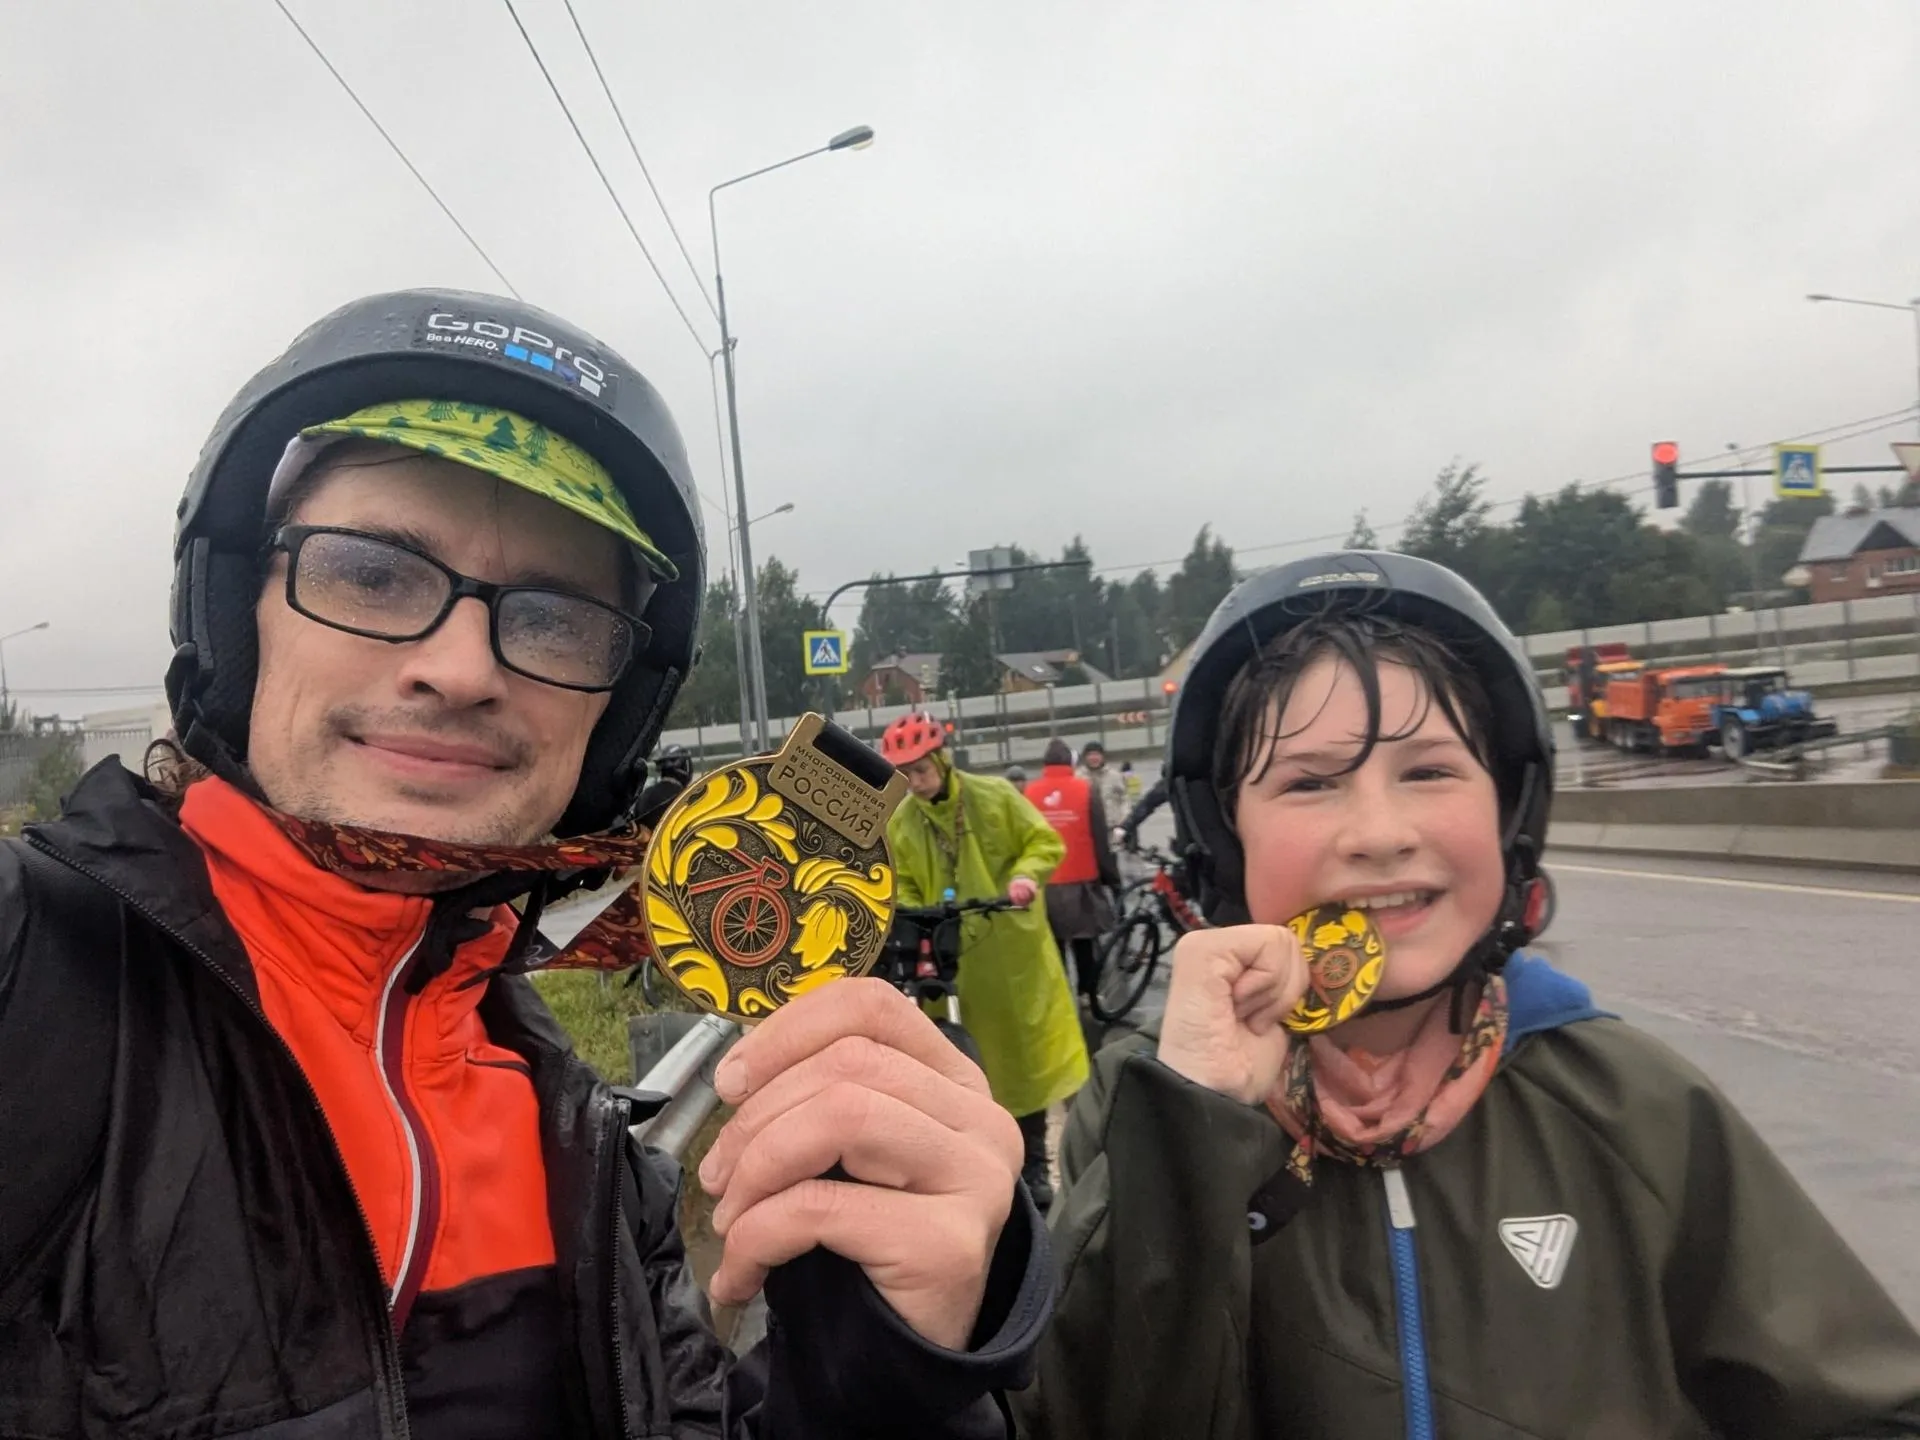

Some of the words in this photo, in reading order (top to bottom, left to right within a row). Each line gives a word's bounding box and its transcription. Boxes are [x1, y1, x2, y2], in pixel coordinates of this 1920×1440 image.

[427, 313, 604, 382] GoPro
[778, 765, 874, 838] РОССИЯ
[789, 754, 879, 820] ВЕЛОГОНКА
